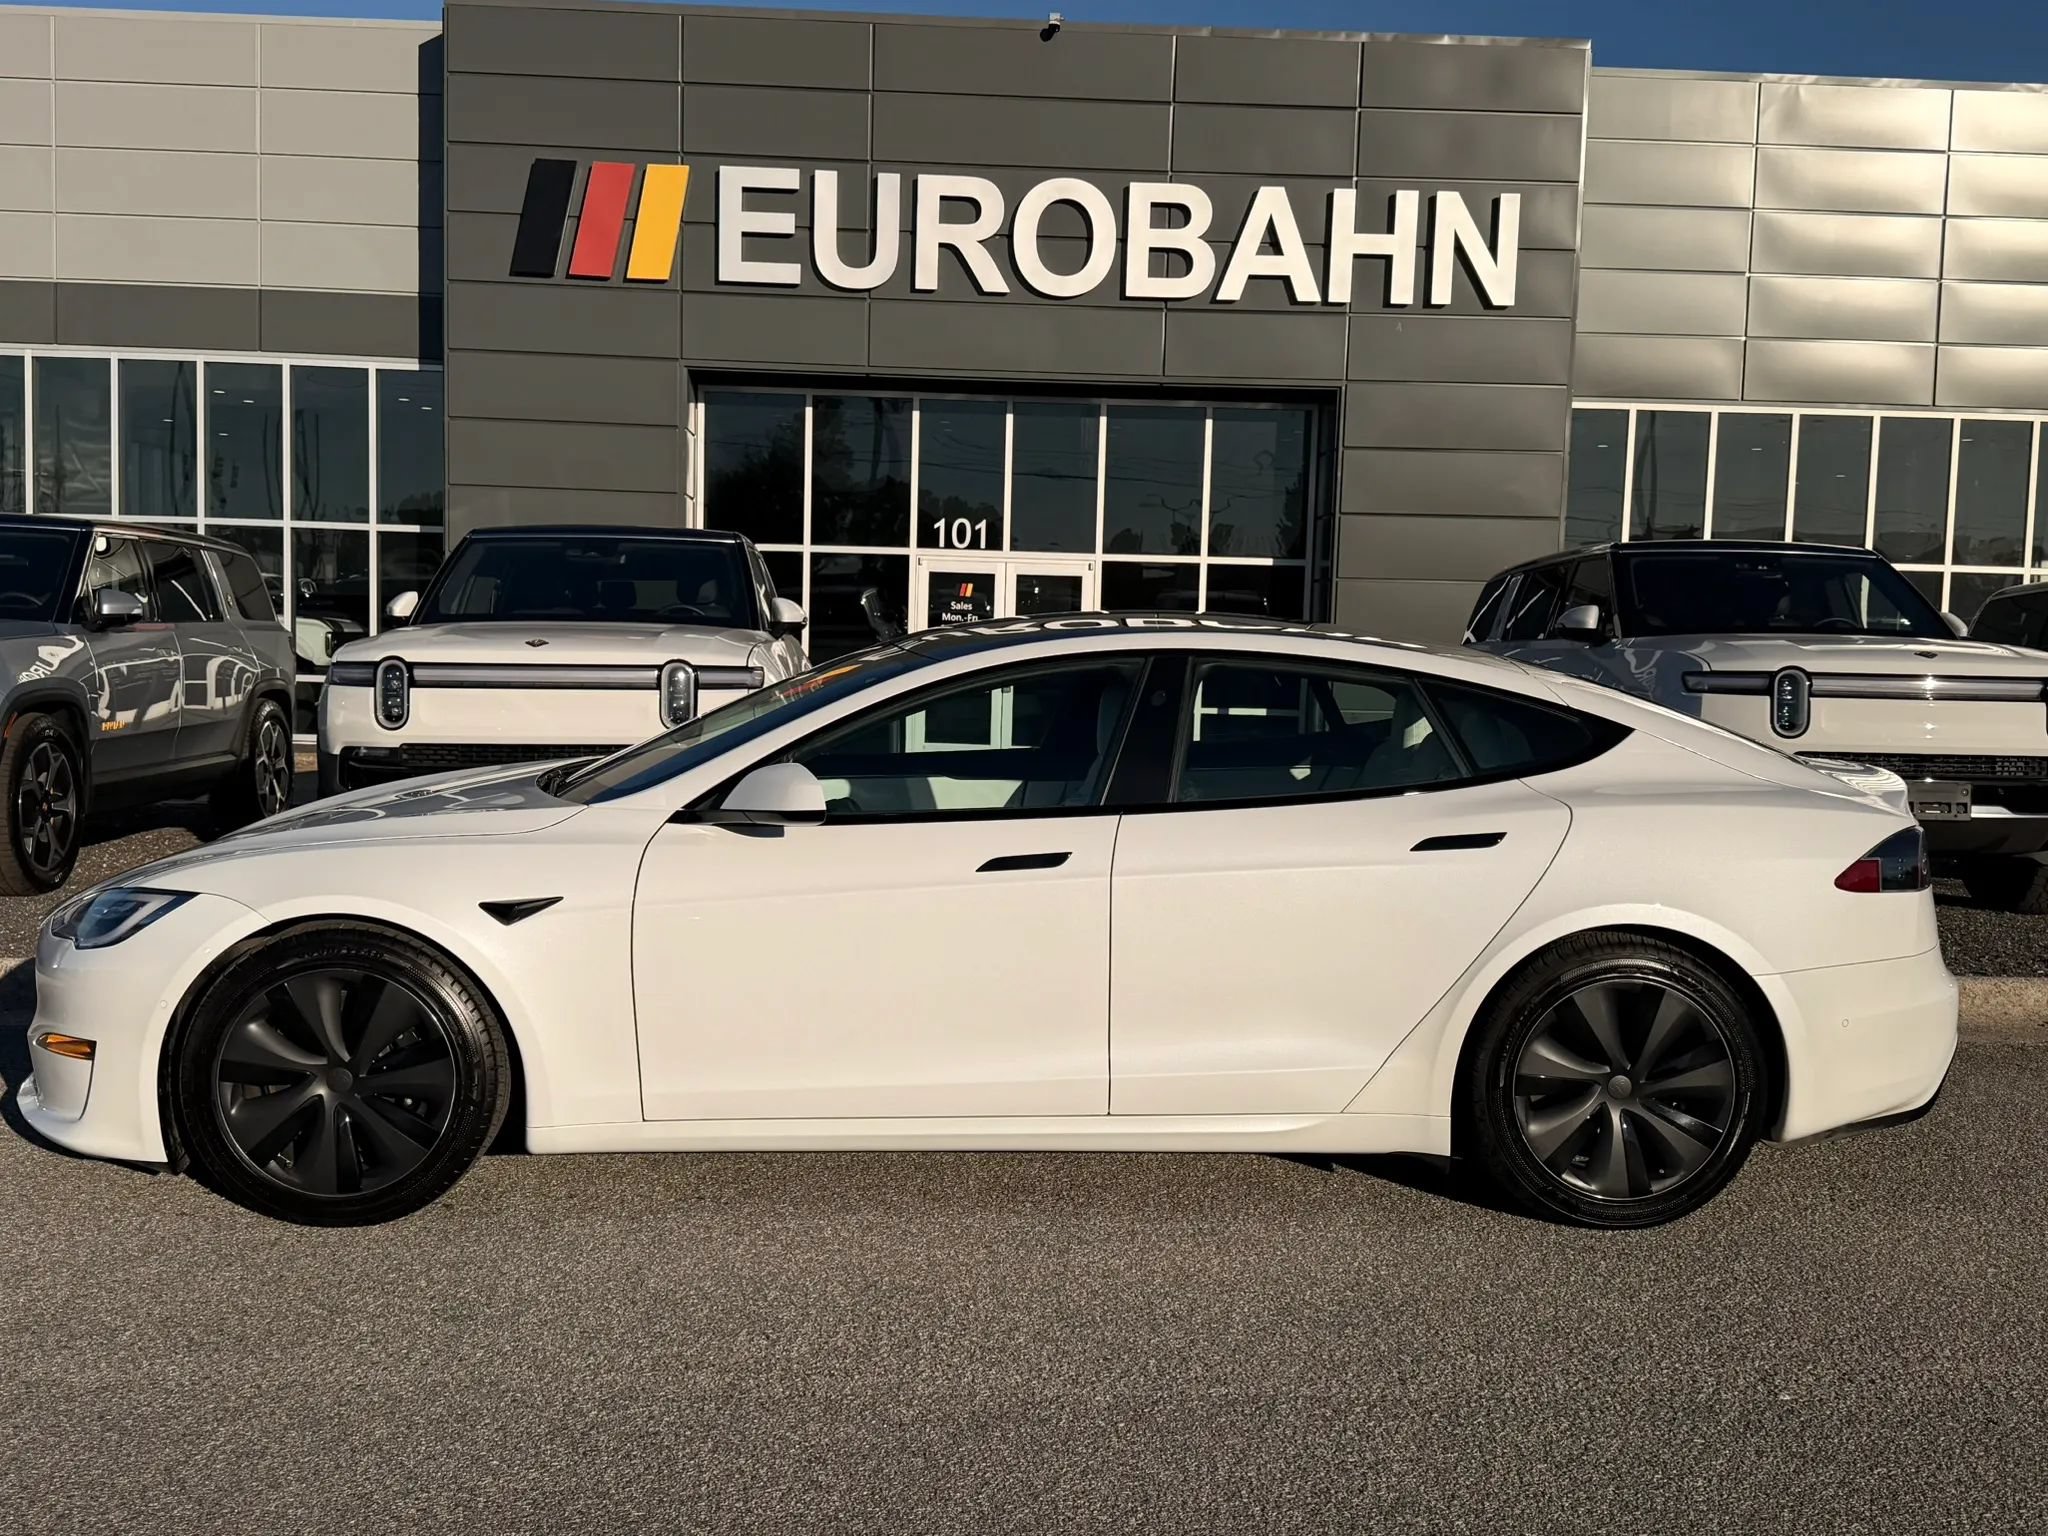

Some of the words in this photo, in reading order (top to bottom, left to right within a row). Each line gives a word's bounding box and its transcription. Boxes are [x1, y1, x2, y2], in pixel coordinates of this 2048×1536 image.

[716, 165, 1521, 307] EUROBAHN
[933, 517, 987, 549] 101
[950, 601, 973, 610] Sales
